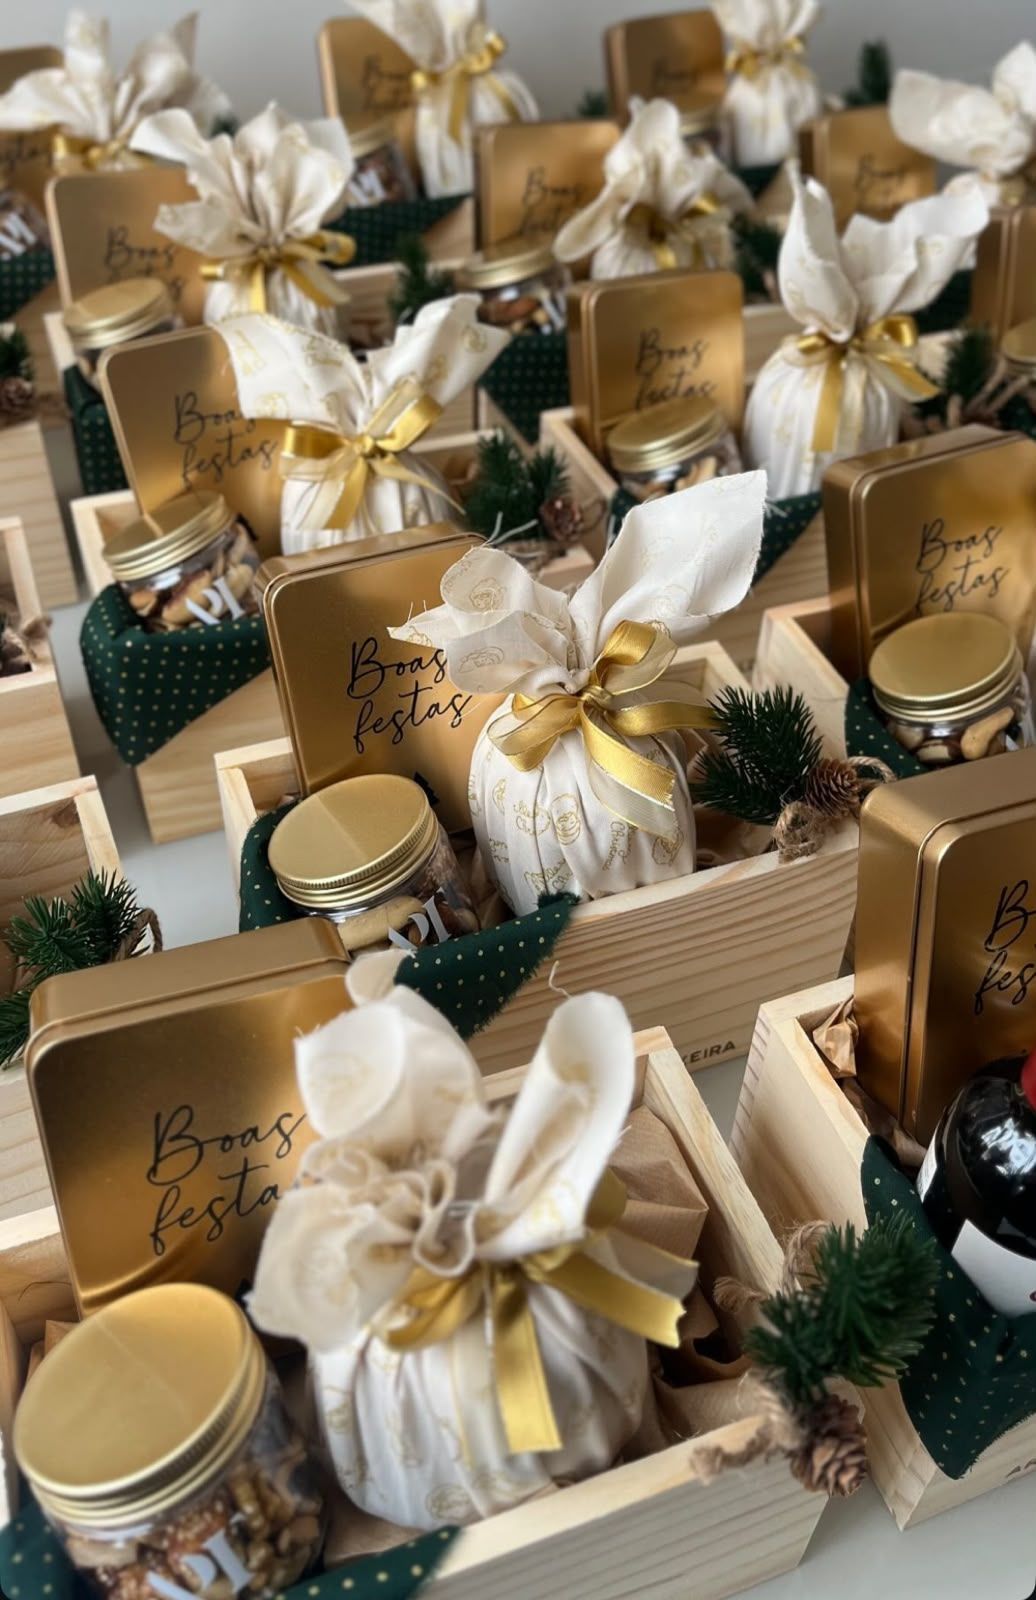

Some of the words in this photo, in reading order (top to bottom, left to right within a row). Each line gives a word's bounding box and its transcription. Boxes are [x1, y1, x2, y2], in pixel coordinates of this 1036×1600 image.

[183, 428, 279, 492] festas
[916, 518, 1004, 574] Boas
[914, 555, 1012, 618] festas
[346, 636, 448, 700] Boas
[353, 680, 473, 755] festas
[974, 950, 1036, 1016] fes
[146, 1104, 307, 1186] Boas
[149, 1156, 283, 1257] festa
